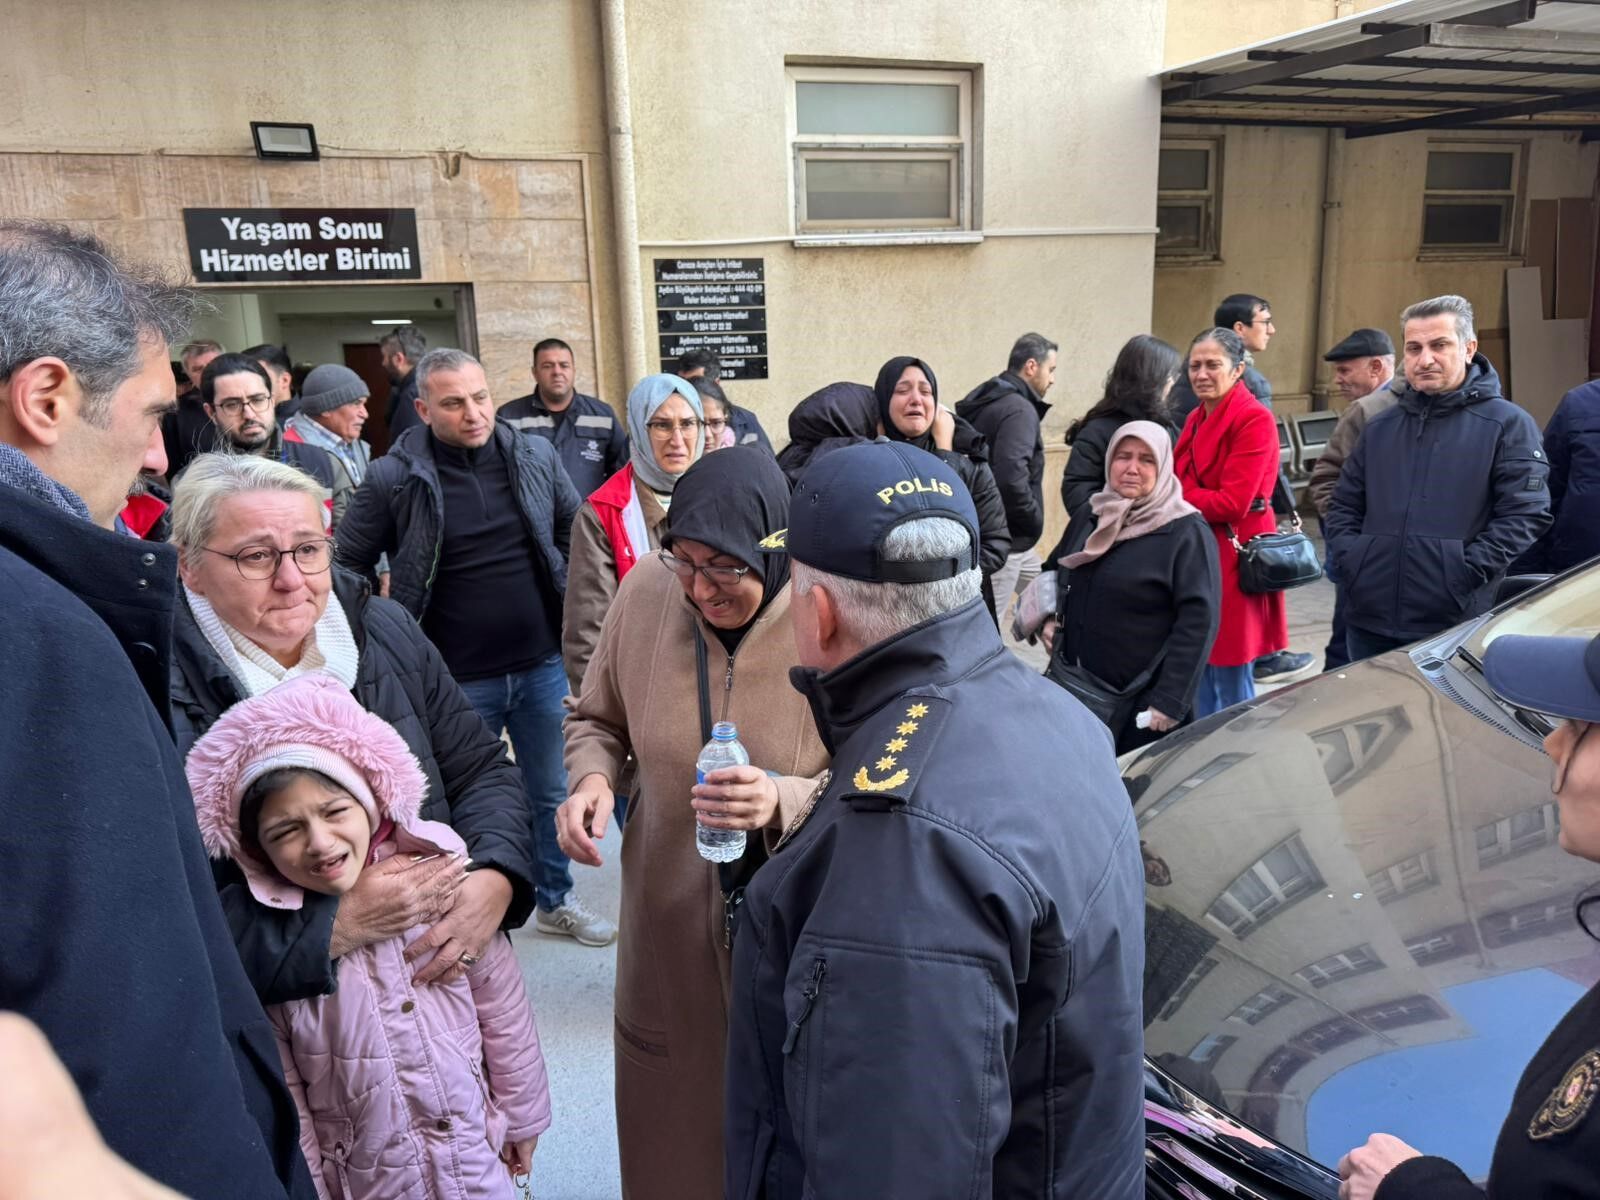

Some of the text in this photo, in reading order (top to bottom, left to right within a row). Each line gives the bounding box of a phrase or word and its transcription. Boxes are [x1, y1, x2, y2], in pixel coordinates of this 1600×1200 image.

[220, 216, 384, 246] Yaşam Sonu
[199, 247, 411, 272] Hizmetler Birimi
